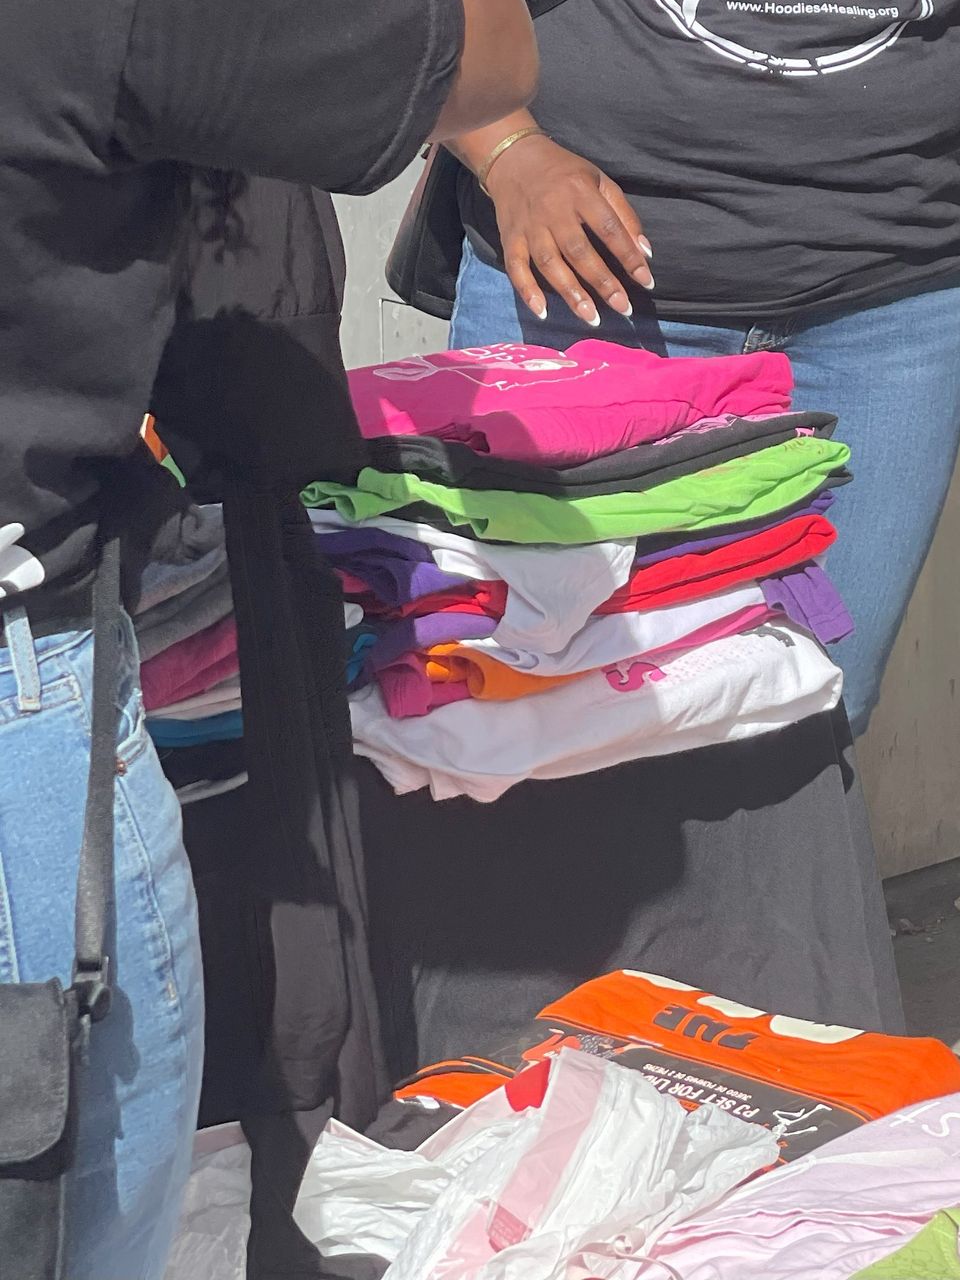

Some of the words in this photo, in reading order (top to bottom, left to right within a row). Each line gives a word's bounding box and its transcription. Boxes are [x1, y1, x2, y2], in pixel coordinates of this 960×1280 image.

[726, 0, 900, 19] www.Hoodies4Healing.org
[673, 1072, 686, 1080] DE
[668, 1082, 704, 1100] FOR
[715, 1085, 728, 1093] DE
[726, 1091, 752, 1101] JUEGO
[699, 1093, 737, 1110] SET
[733, 1104, 760, 1119] PJ
